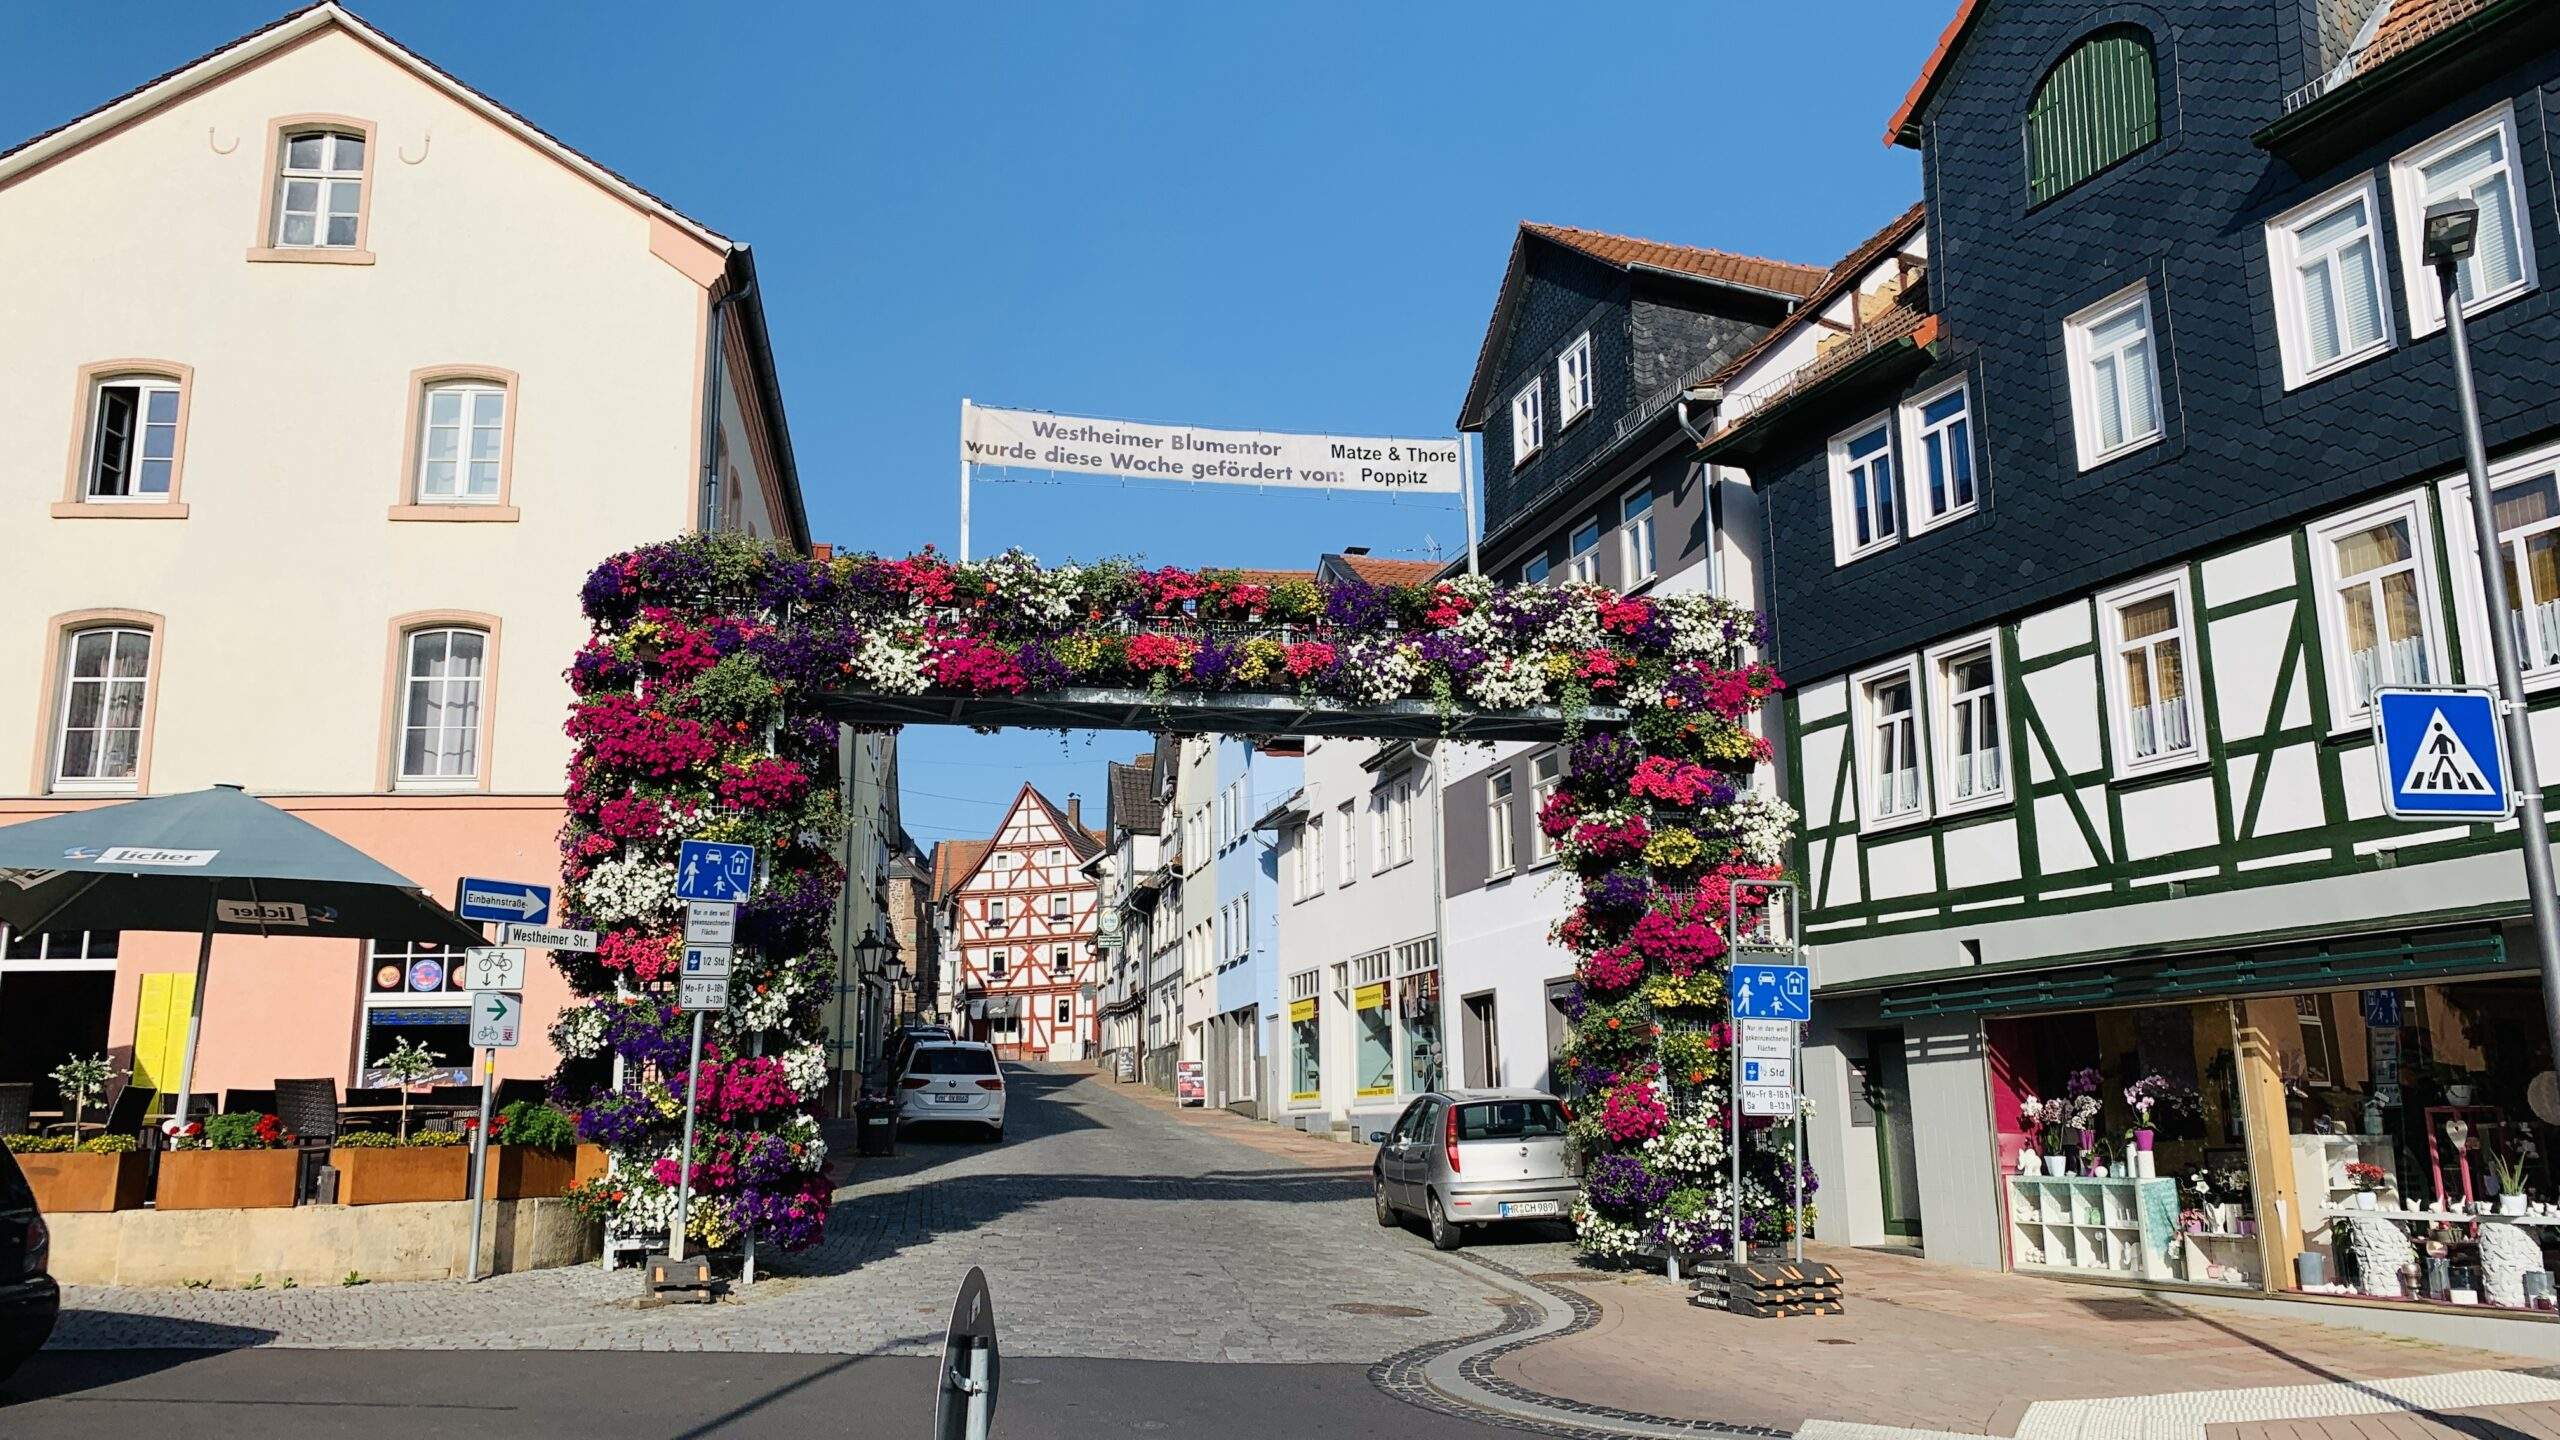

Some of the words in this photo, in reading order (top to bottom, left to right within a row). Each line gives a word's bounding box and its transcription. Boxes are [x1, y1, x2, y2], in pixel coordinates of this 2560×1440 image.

[1032, 420, 1163, 449] Westheimer
[1172, 434, 1281, 456] Blumentor
[1331, 444, 1382, 461] Matze
[1388, 447, 1401, 462] &
[1406, 447, 1457, 463] Thore
[966, 440, 1037, 460] wurde
[1045, 446, 1103, 466] diese
[1111, 453, 1184, 474] Woche
[1192, 462, 1293, 480] gefördert
[1300, 470, 1345, 483] von:
[1361, 468, 1428, 487] Poppitz
[115, 849, 199, 862] Licher
[468, 893, 527, 909] Einbahnstraße
[513, 928, 569, 947] Westheimer
[573, 934, 590, 948] Str.
[685, 982, 705, 993] Mo-Fr
[684, 995, 692, 1005] Sa
[1770, 1067, 1785, 1077] Std
[1746, 1089, 1766, 1099] Mo-Fr
[1746, 1101, 1756, 1110] Sa
[1524, 1203, 1537, 1213] CH
